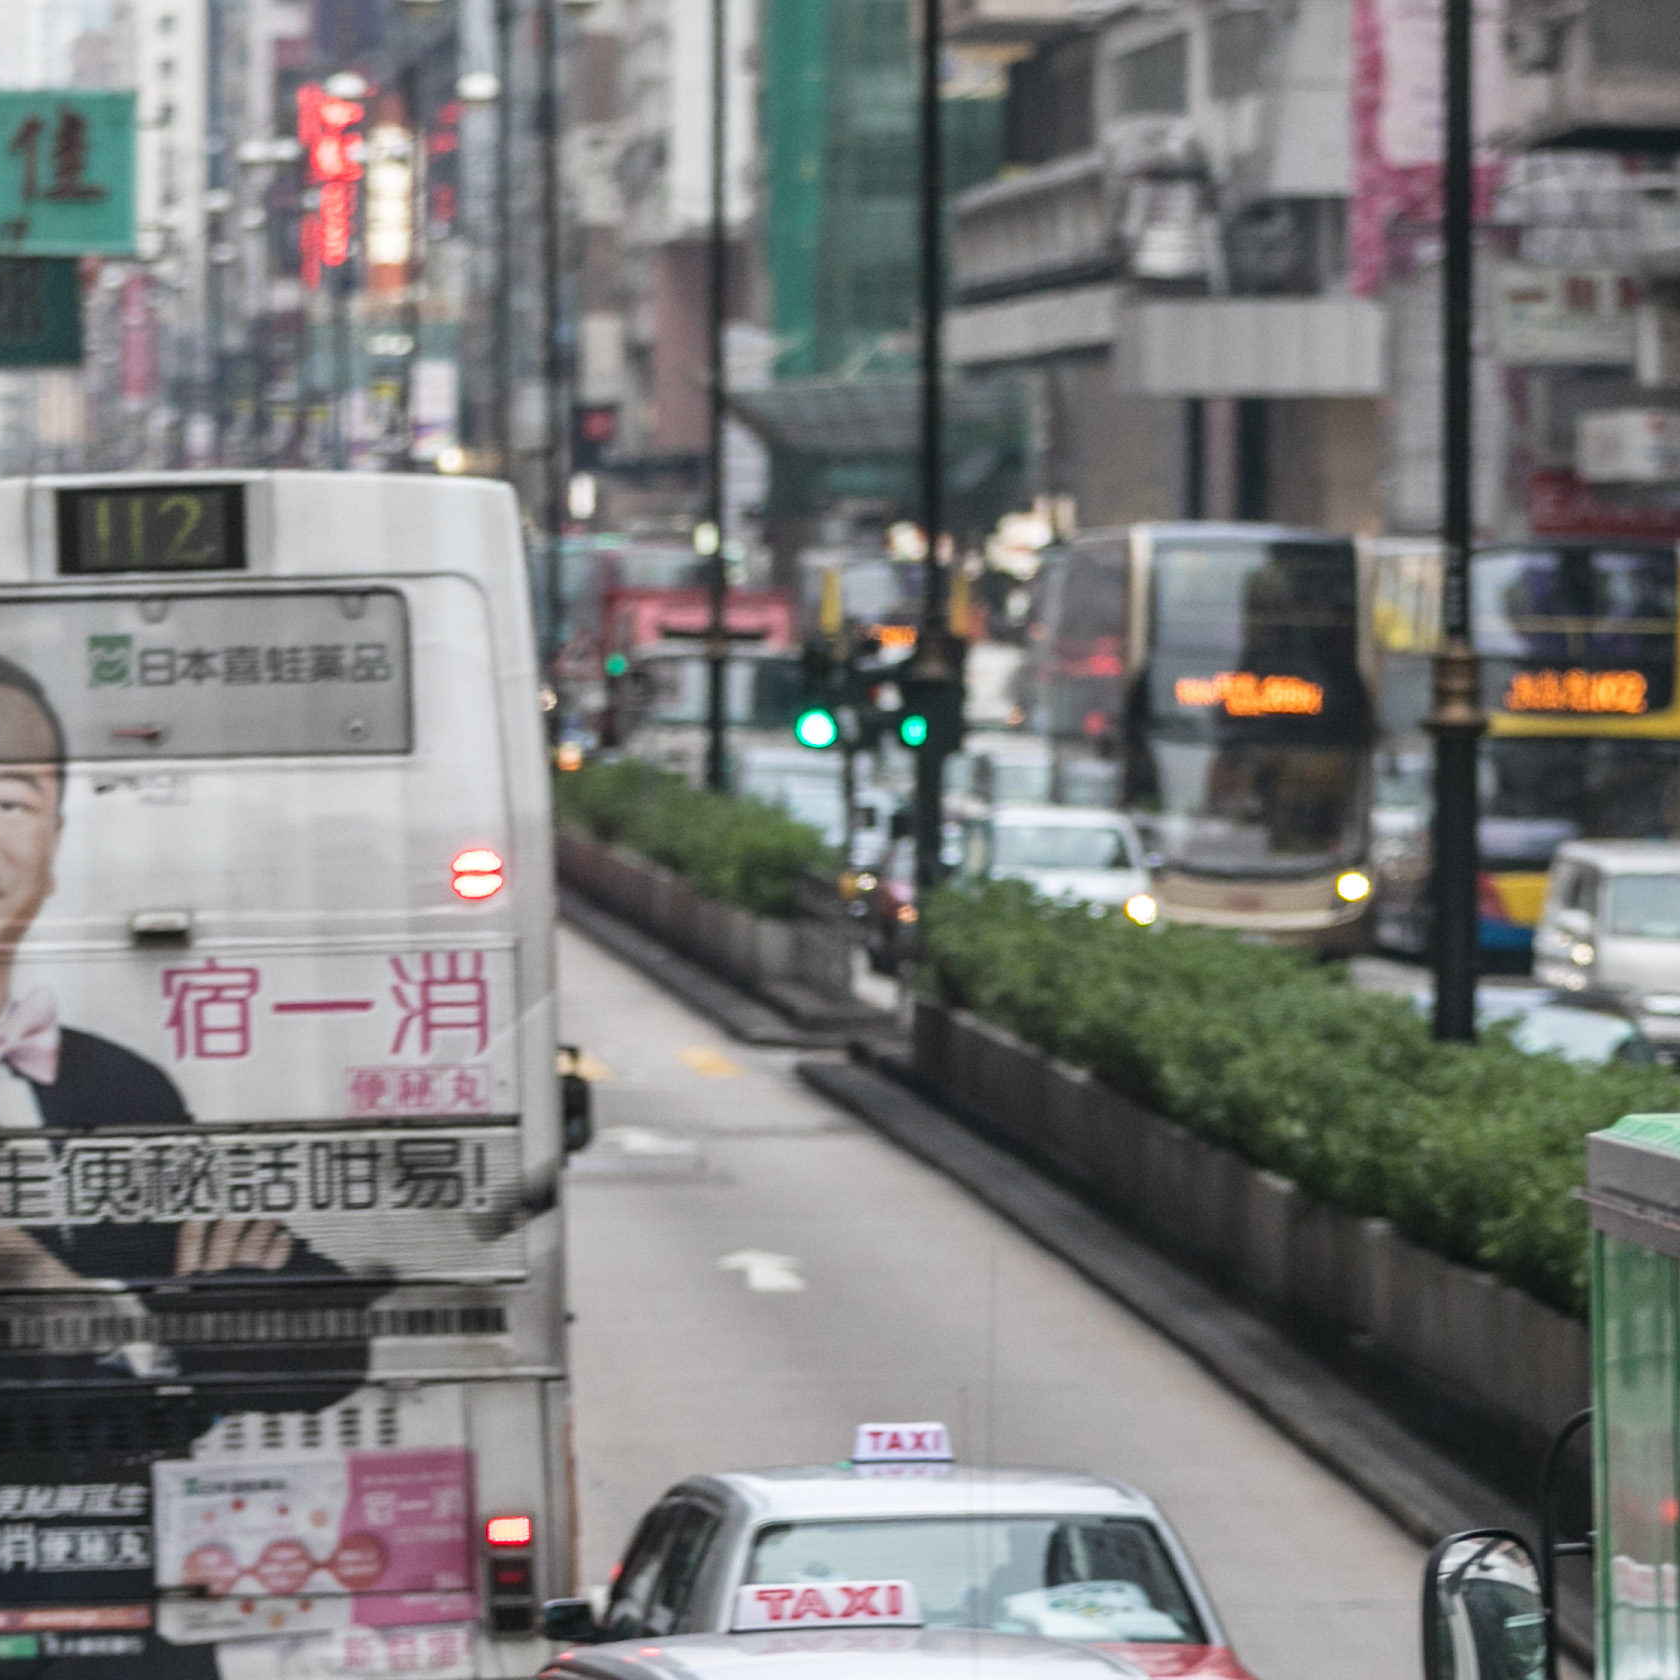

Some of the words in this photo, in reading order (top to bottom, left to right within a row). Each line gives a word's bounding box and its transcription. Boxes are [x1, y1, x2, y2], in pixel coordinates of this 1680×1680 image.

[93, 495, 206, 563] 112
[161, 950, 491, 1060] 宿一消
[867, 1430, 942, 1452] TAXI
[755, 1584, 903, 1621] TAXI
